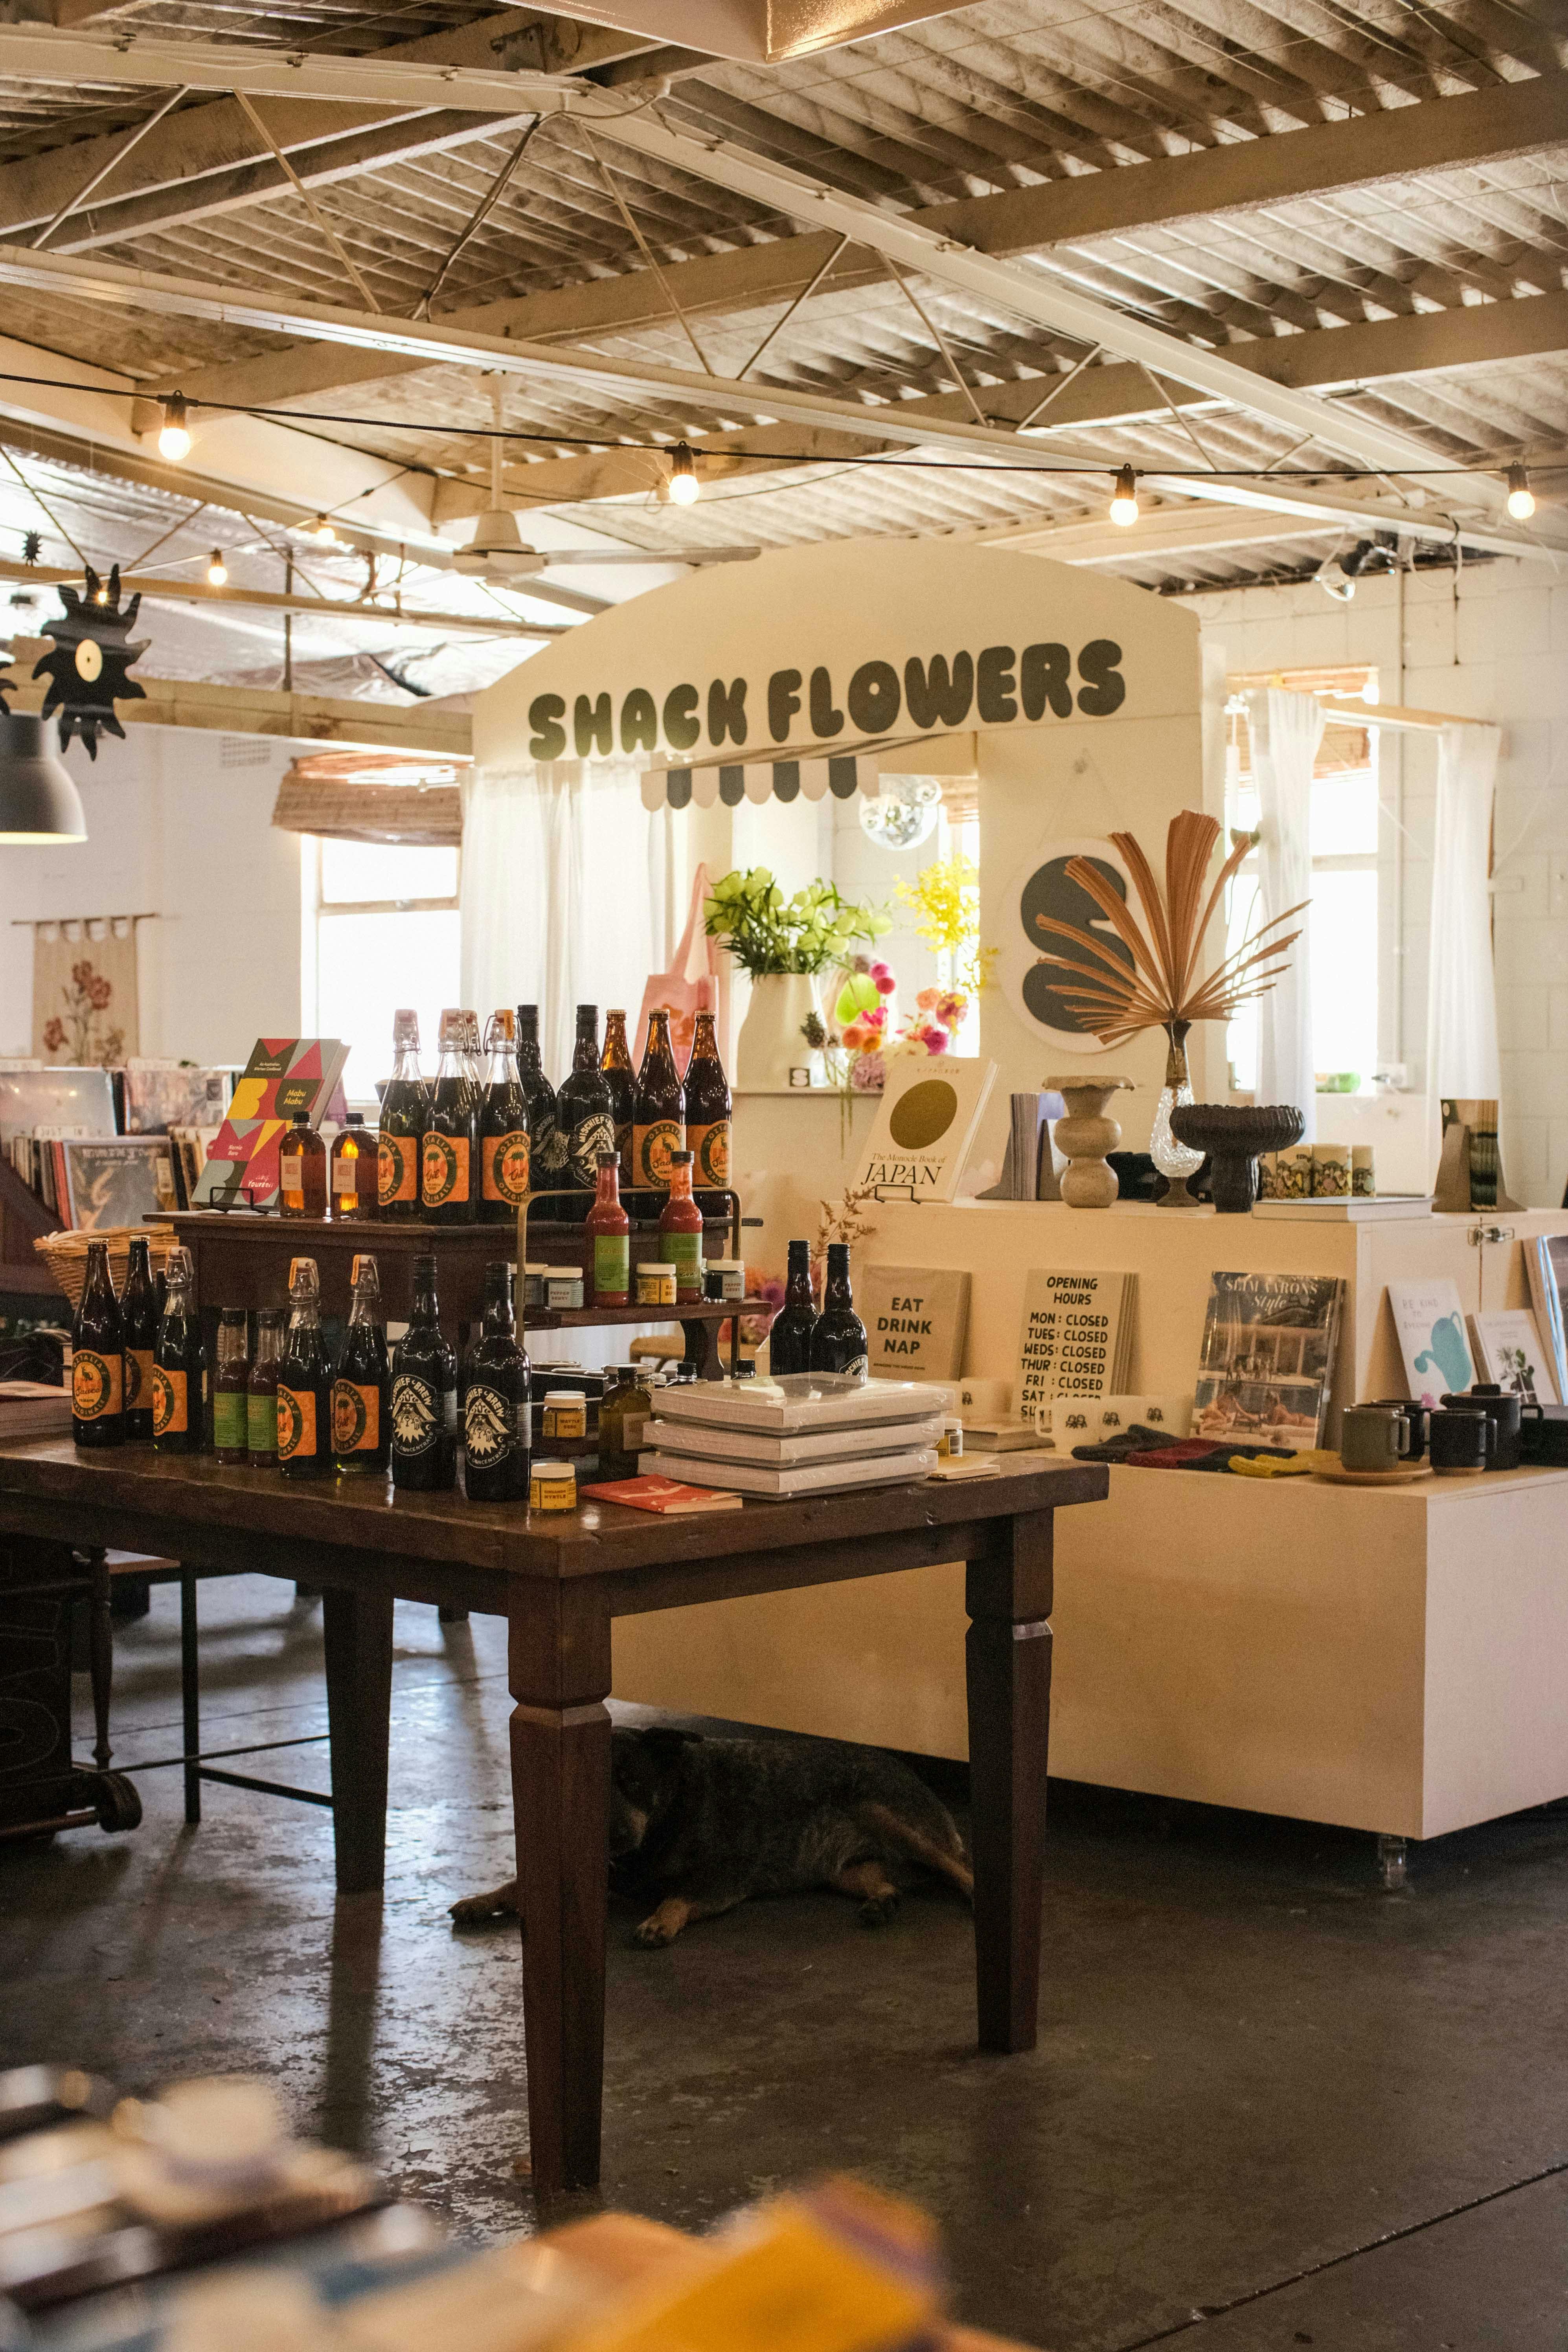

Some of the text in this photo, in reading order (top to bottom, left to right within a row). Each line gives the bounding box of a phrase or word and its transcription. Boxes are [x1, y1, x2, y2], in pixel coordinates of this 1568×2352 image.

[528, 639, 1125, 762] SHACK FLOWERS
[579, 1116, 605, 1143] MISCHIEF
[652, 1157, 671, 1169] Sau
[887, 1154, 916, 1162] Monocle
[860, 1163, 942, 1185] JAPAN
[1047, 1276, 1098, 1290] OPENING
[892, 1297, 923, 1312] EAT
[1053, 1292, 1092, 1305] HOURS
[1255, 1295, 1287, 1316] Style
[877, 1317, 932, 1334] DRINK
[1066, 1314, 1108, 1327] CLOSED
[1064, 1330, 1108, 1343] CLOSED
[884, 1339, 920, 1354] NAP
[1062, 1346, 1106, 1359] CLOSED
[1060, 1361, 1105, 1374] CLOSED
[1059, 1377, 1103, 1390] CLOSED
[414, 1382, 432, 1406] BREW
[486, 1393, 504, 1417] BREW
